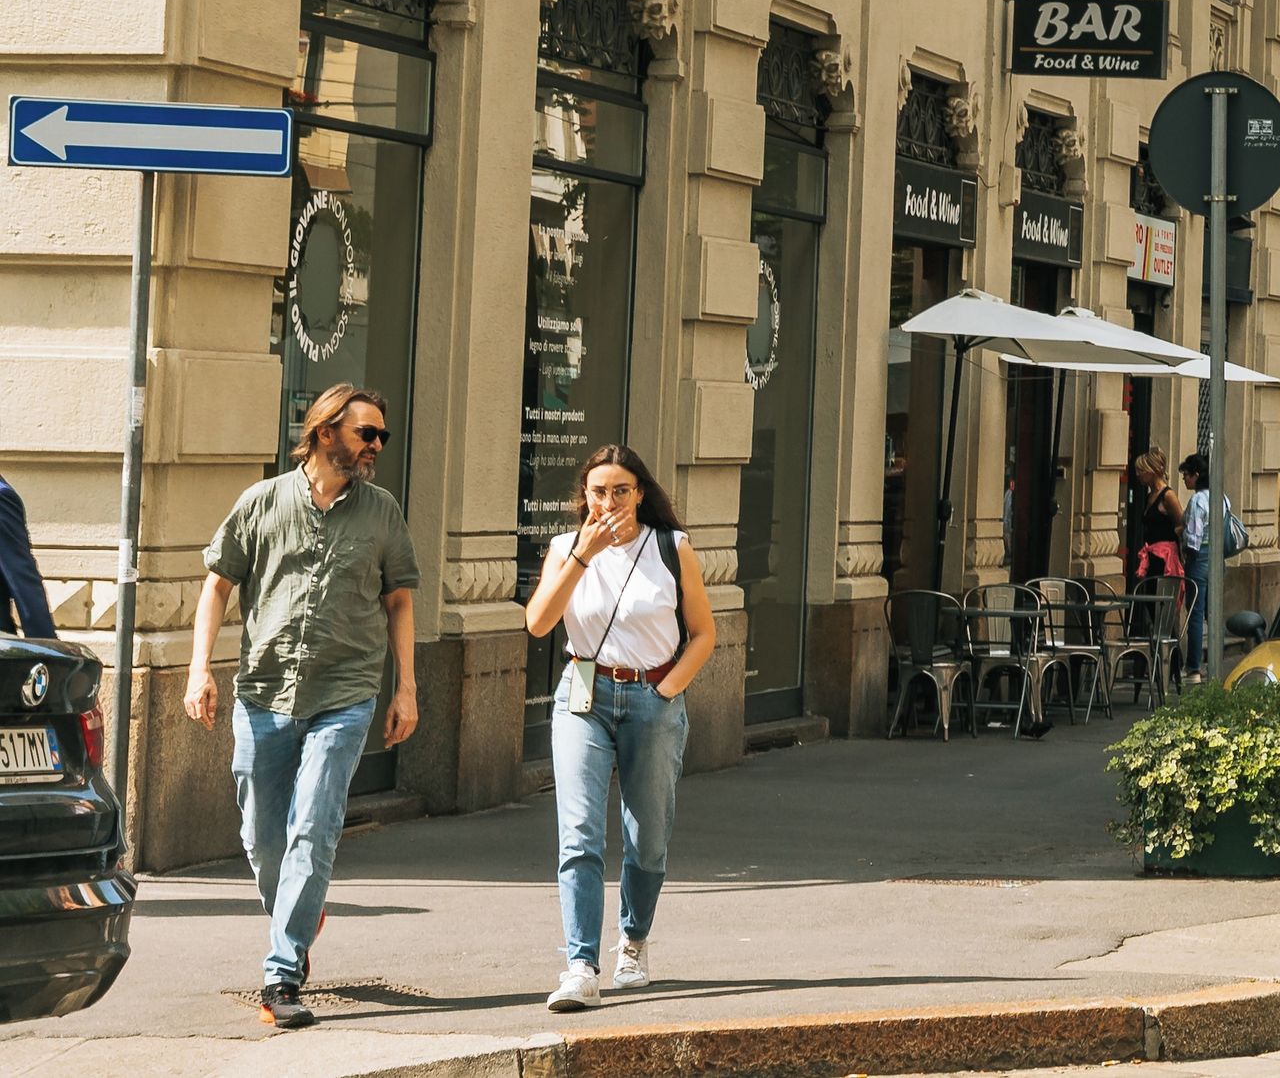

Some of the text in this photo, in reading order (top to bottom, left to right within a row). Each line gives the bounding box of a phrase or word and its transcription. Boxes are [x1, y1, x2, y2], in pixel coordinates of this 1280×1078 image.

[1033, 2, 1142, 45] BAR
[1034, 54, 1140, 71] Food & Wine
[328, 193, 347, 230] NON
[905, 184, 960, 226] Food & Wine
[291, 190, 328, 268] GIOVANE
[1021, 211, 1069, 248] Food & Wine
[1153, 258, 1172, 275] OUTLET
[289, 274, 297, 299] IL
[291, 303, 319, 362] PLINIO
[320, 310, 349, 361] SOGNA
[525, 407, 540, 420] Tutti
[562, 410, 585, 424] prodotti
[523, 499, 538, 512] Tutti
